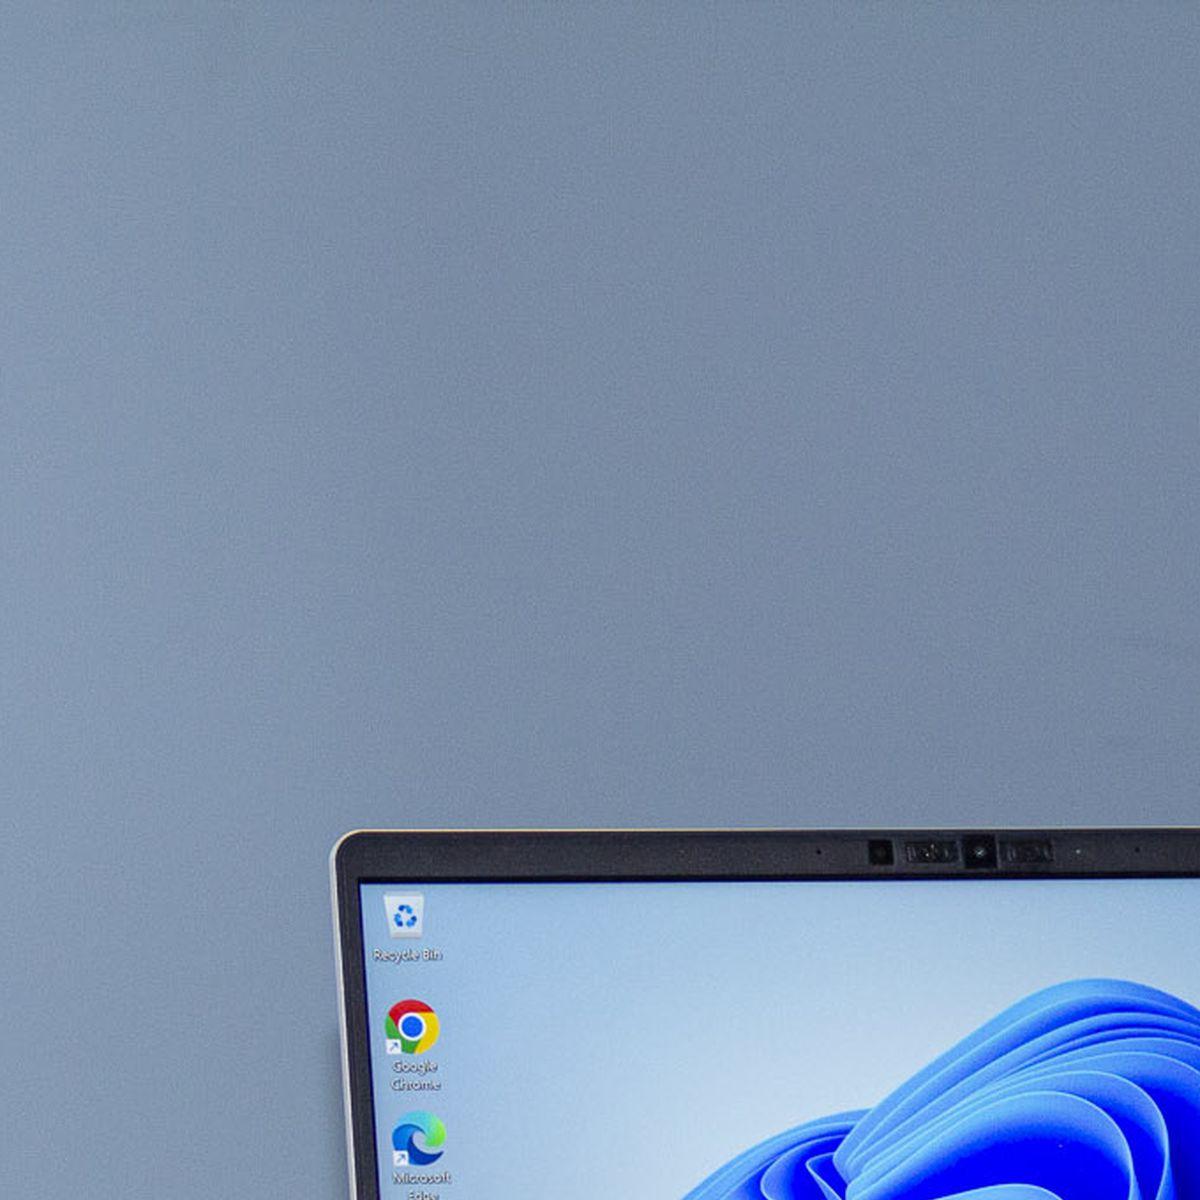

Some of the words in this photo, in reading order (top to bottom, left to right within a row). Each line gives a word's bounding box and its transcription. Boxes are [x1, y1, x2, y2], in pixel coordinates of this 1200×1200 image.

[373, 949, 420, 964] Recycle
[423, 949, 443, 961] Bin
[393, 1061, 438, 1075] Google
[392, 1079, 441, 1091] Chrome
[393, 1172, 451, 1184] Microsoft
